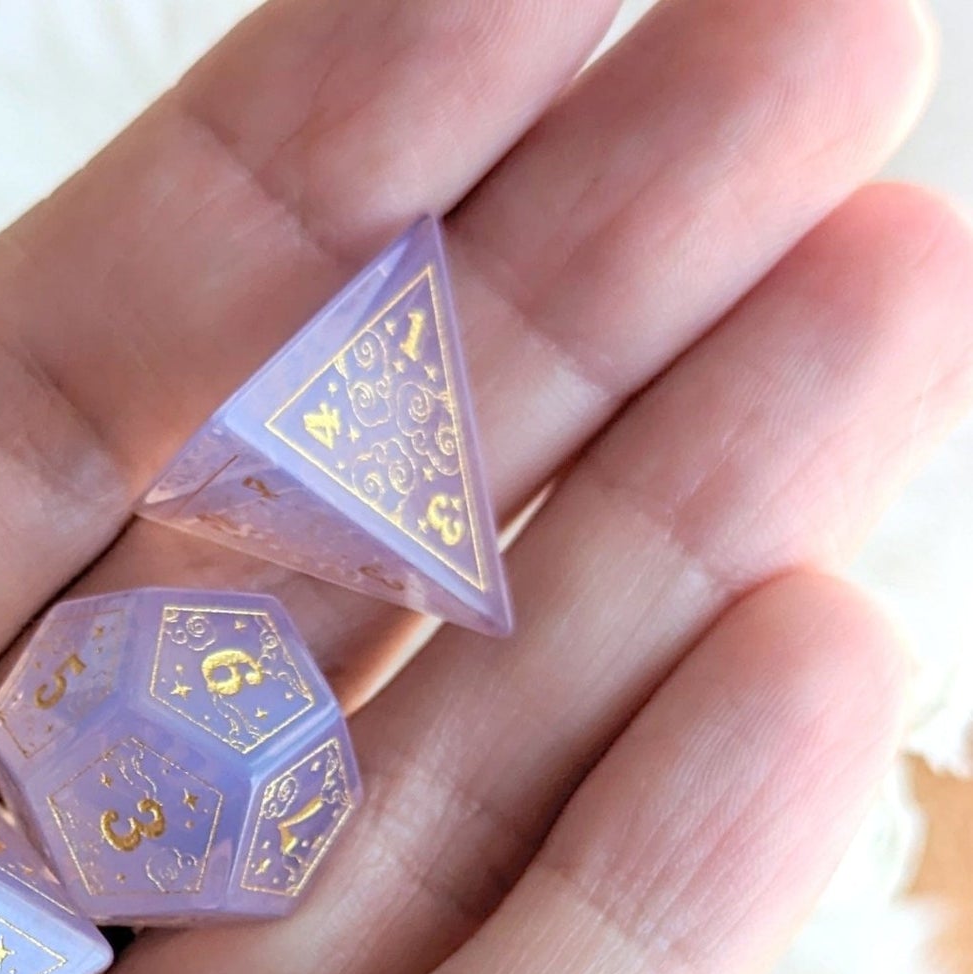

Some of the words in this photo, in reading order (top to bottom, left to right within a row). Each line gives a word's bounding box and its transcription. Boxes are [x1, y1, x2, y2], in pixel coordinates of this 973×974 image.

[401, 311, 425, 361] 1
[303, 402, 342, 450] 4
[426, 494, 465, 546] 3
[34, 653, 87, 710] 5
[100, 797, 167, 852] 3
[277, 795, 325, 855] 7
